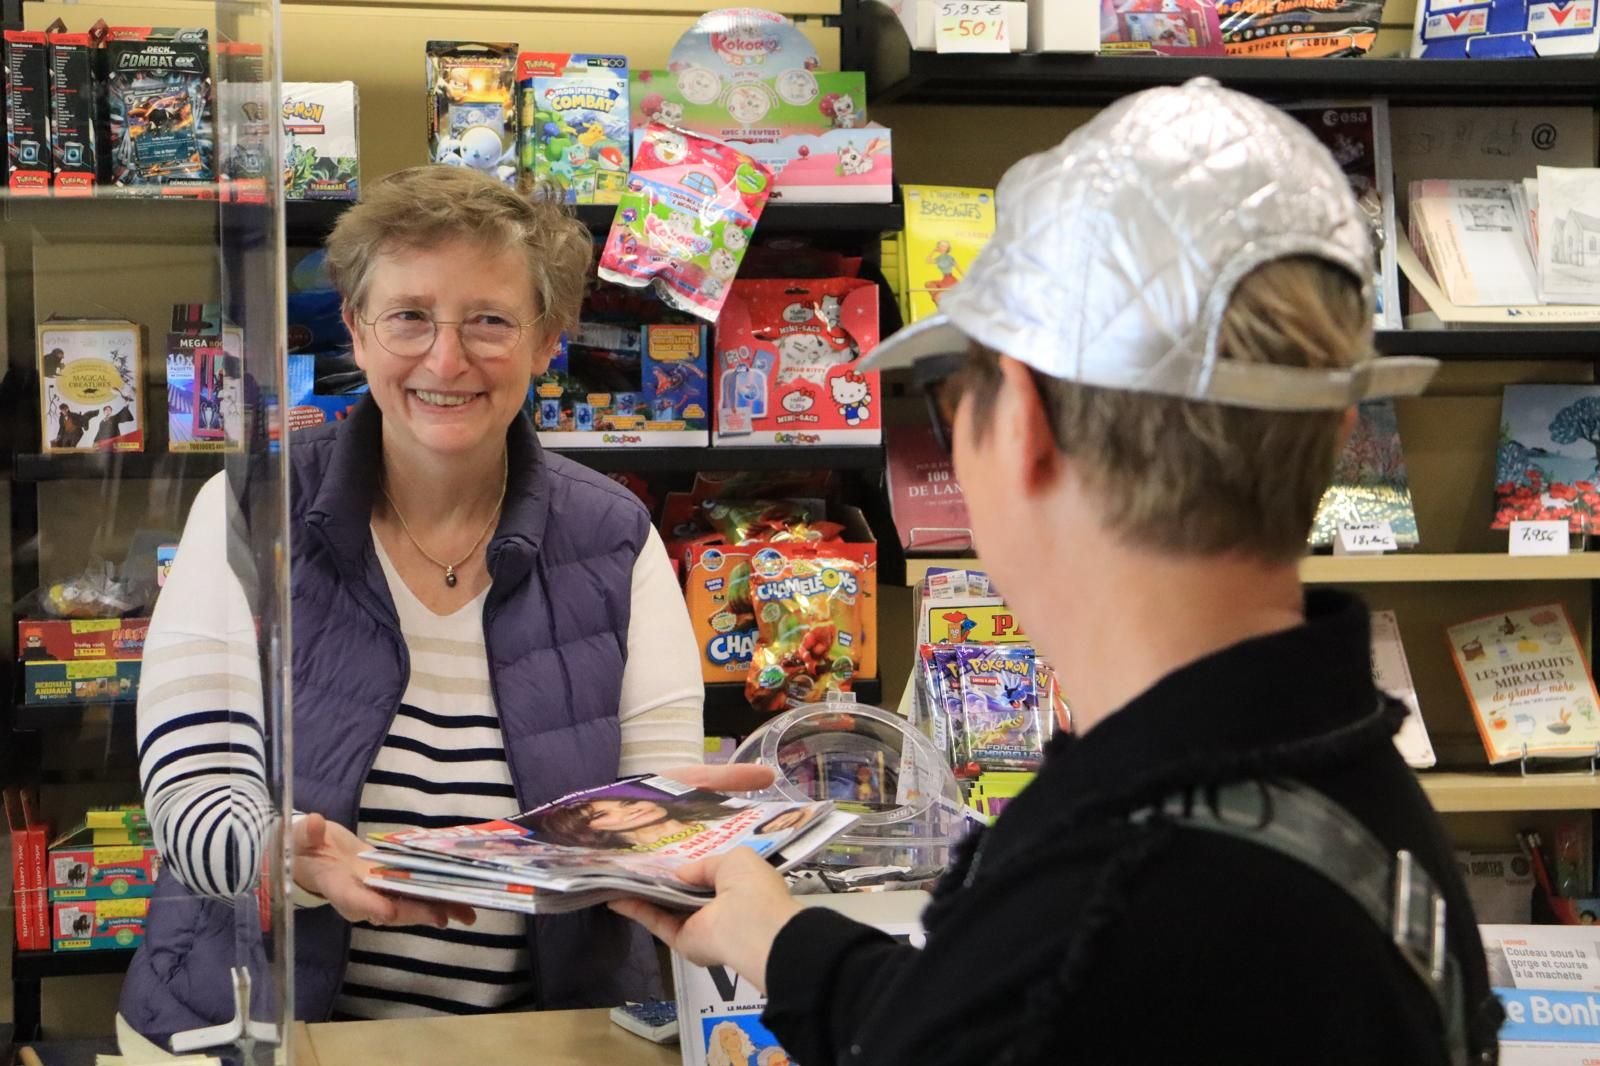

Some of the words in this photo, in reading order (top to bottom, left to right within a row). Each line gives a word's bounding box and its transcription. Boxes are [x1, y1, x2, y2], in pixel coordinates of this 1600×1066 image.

[146, 46, 171, 54] DECK
[120, 53, 173, 68] COMBAT
[552, 95, 614, 113] COMBAT
[180, 340, 208, 348] MEGA
[928, 472, 949, 482] 100
[908, 486, 928, 497] DE
[757, 568, 858, 600] CHAMELEONS
[1475, 668, 1499, 681] LES
[1501, 656, 1575, 675] PRODUITS
[1495, 669, 1565, 689] MIRACLES
[1506, 948, 1548, 958] Couteau
[1550, 949, 1575, 958] sous
[1575, 948, 1586, 959] la
[1511, 959, 1540, 969] gorge
[1541, 959, 1551, 968] et
[1553, 961, 1589, 970] course
[1523, 970, 1534, 978] la
[1535, 970, 1583, 981] machette
[1505, 1000, 1525, 1024] e
